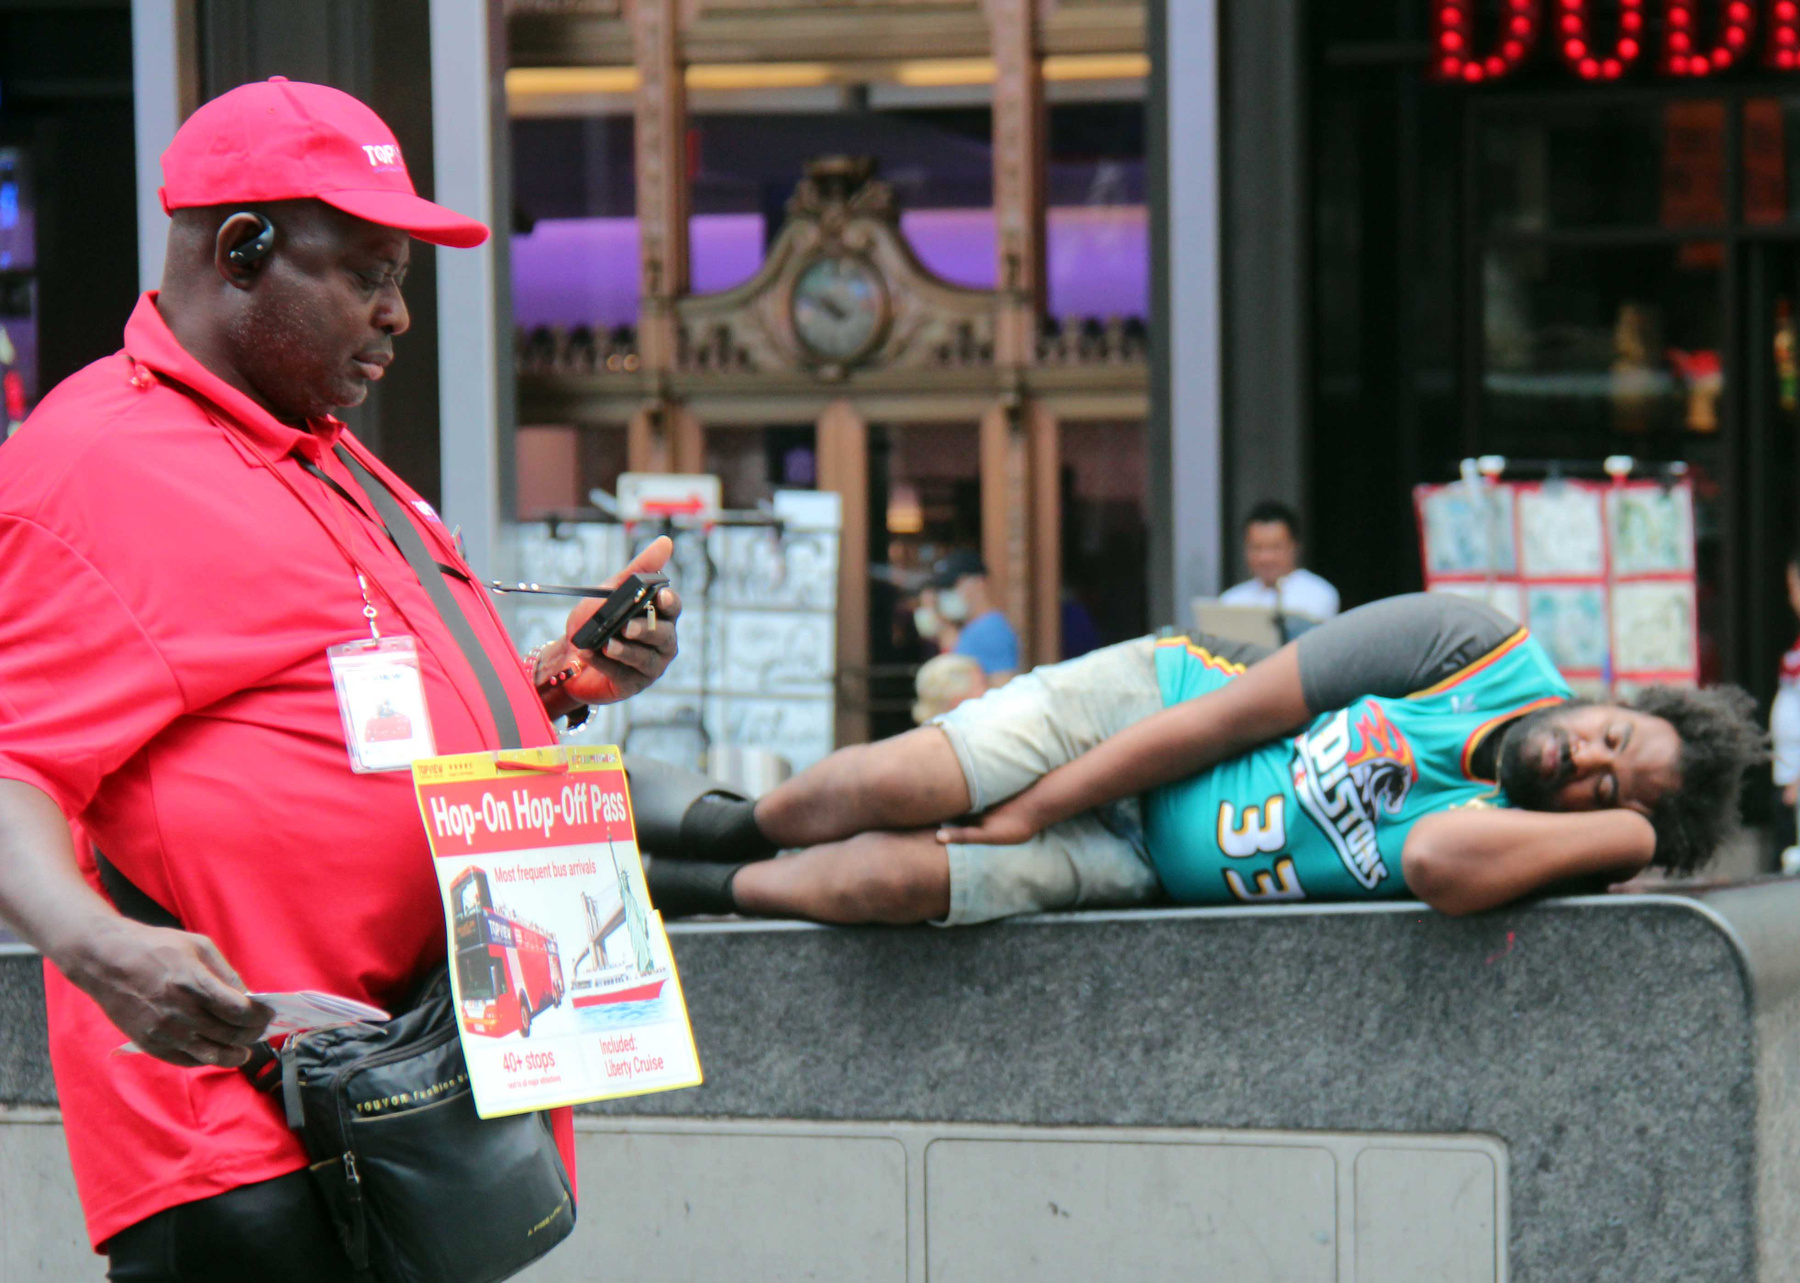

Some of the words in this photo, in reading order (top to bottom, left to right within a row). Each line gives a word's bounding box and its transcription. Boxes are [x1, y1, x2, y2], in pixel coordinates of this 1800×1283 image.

[430, 792, 512, 845] Hop-On
[512, 782, 588, 838] Hop-Off
[590, 783, 626, 824] Pass
[1217, 792, 1306, 900] 33
[494, 866, 516, 882] Most
[516, 864, 552, 884] frequent
[552, 861, 567, 877] bus
[568, 858, 597, 876] arrivals
[599, 1034, 638, 1055] Included:
[503, 1052, 523, 1073] 40+
[525, 1050, 556, 1073] stops
[605, 1057, 632, 1079] Liberty
[633, 1054, 664, 1074] Cruise
